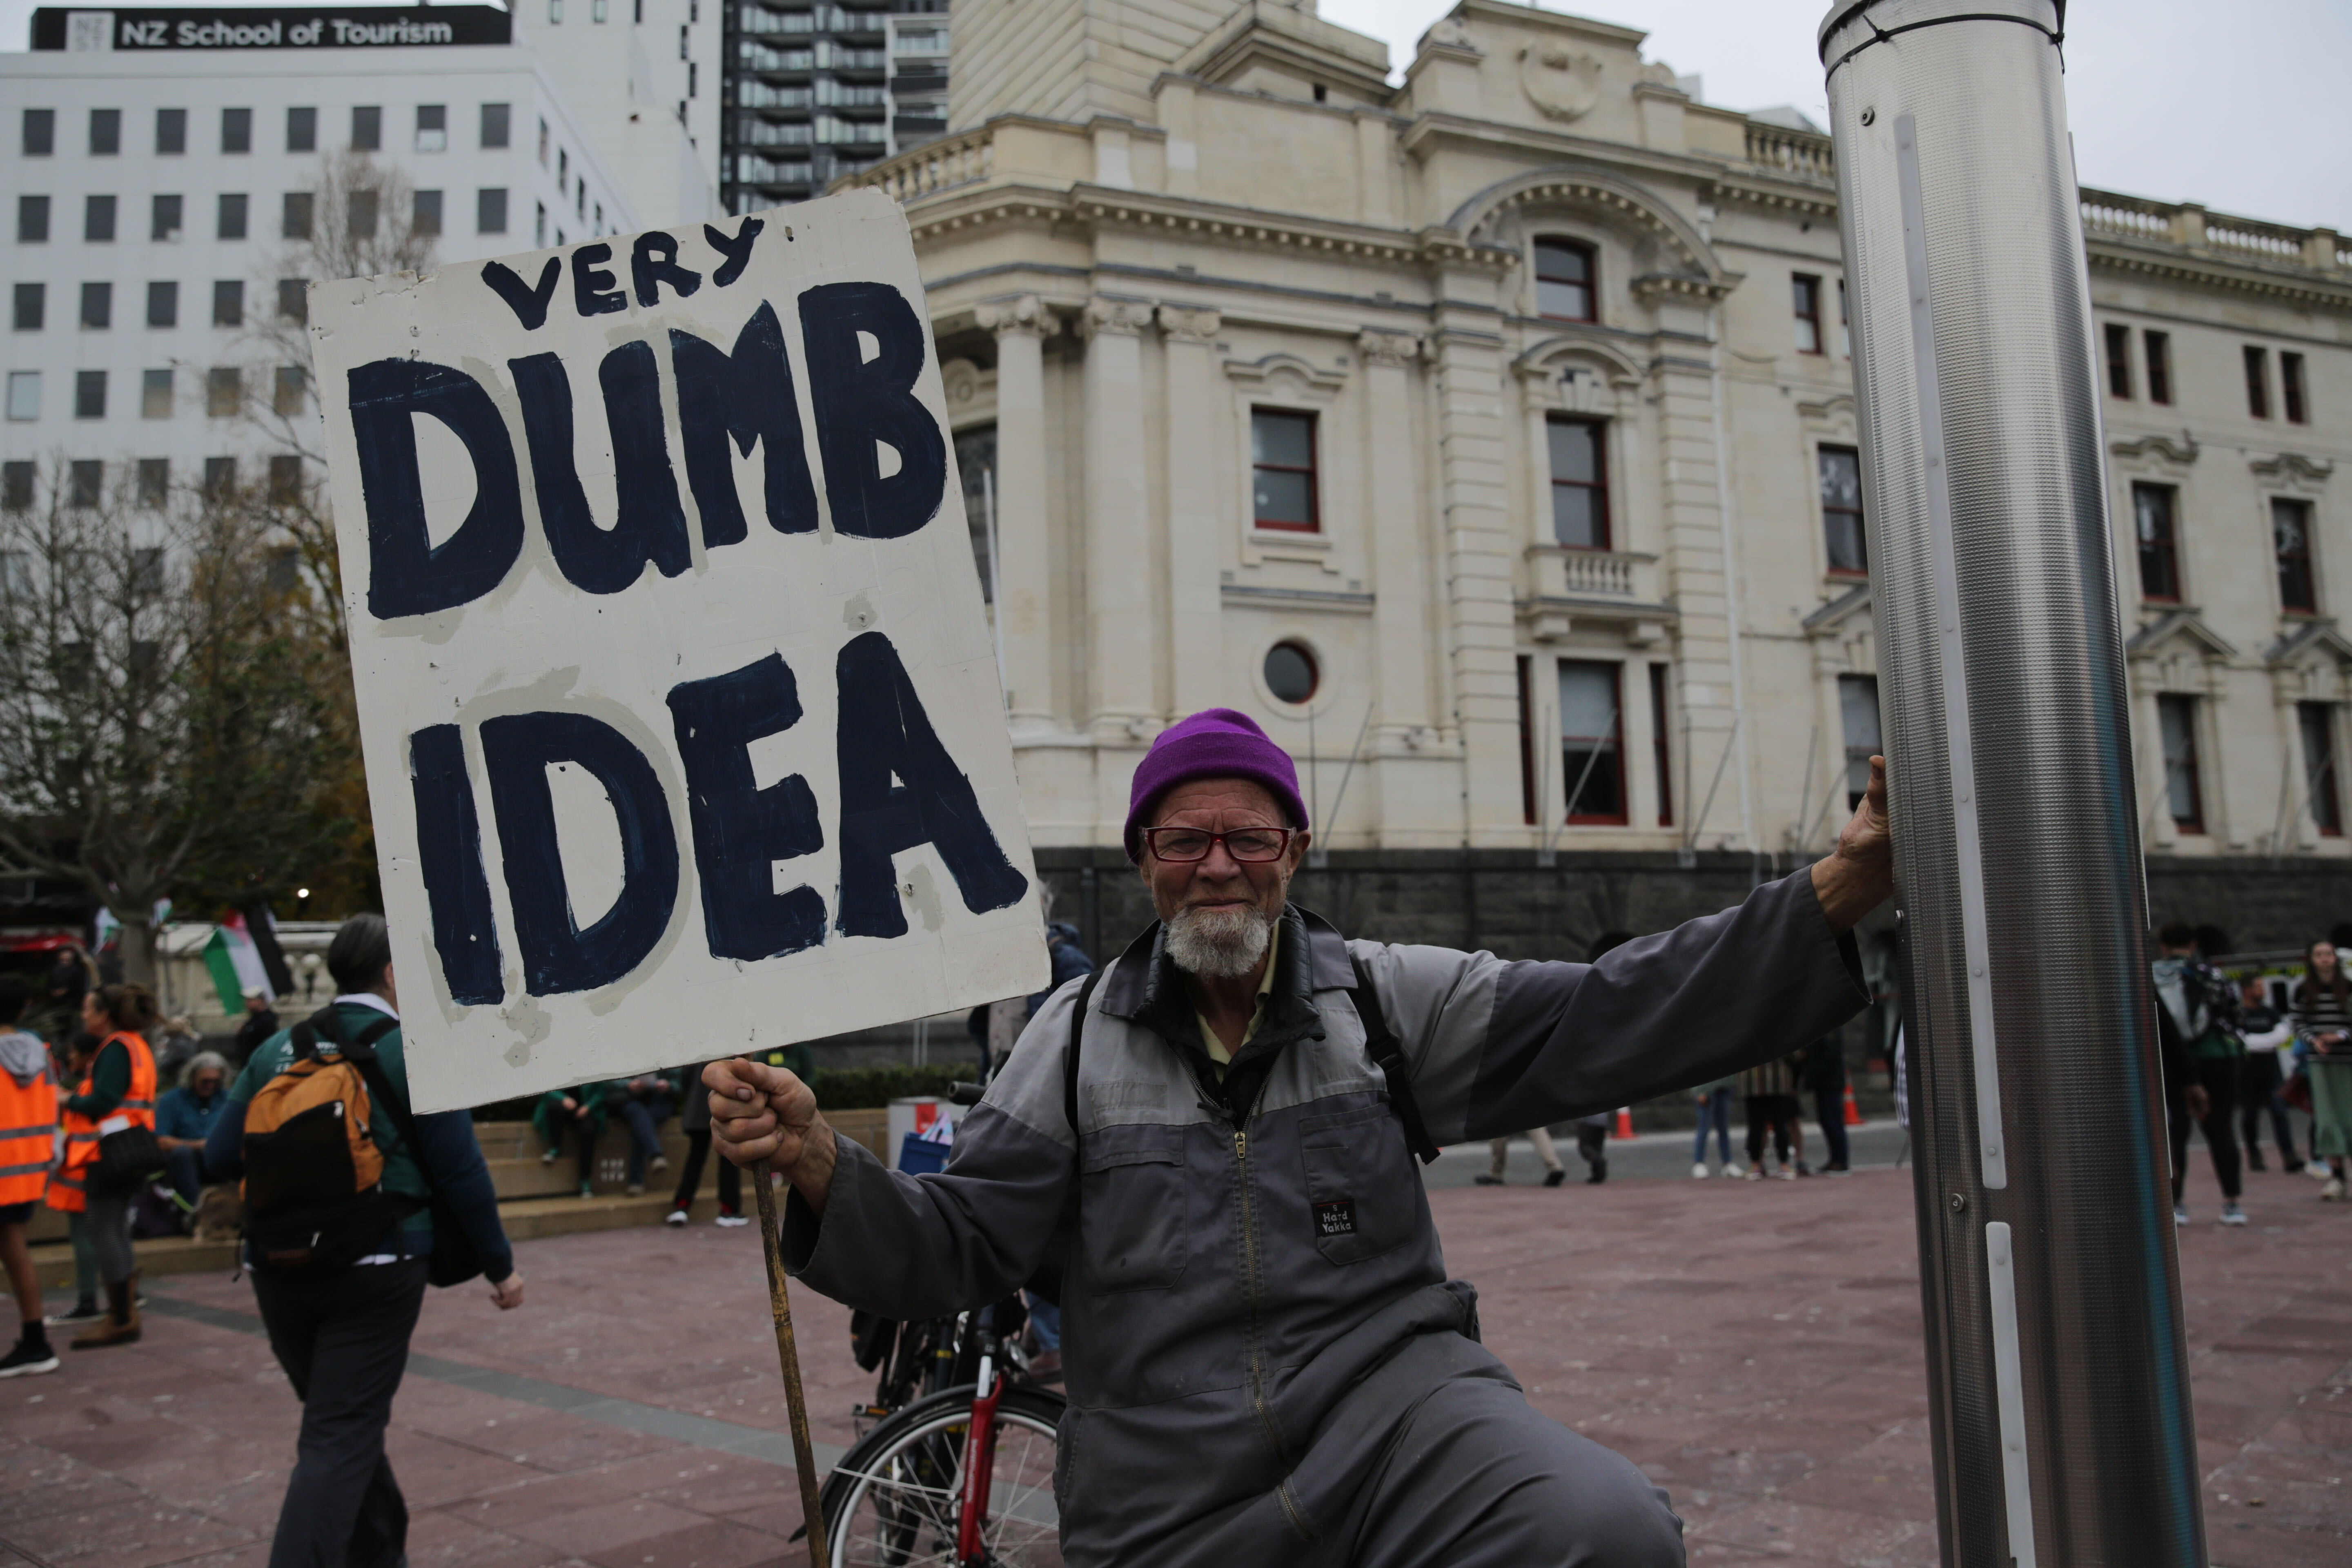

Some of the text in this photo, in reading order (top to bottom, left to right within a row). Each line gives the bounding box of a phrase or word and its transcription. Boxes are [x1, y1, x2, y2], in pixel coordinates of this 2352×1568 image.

[122, 16, 452, 46] NZ School of Tourism
[481, 216, 765, 331] VERY
[347, 281, 947, 620] DUMB
[410, 631, 1028, 1005] IDEA
[1322, 1222, 1352, 1233] Yakka
[1323, 1211, 1348, 1222] Hard
